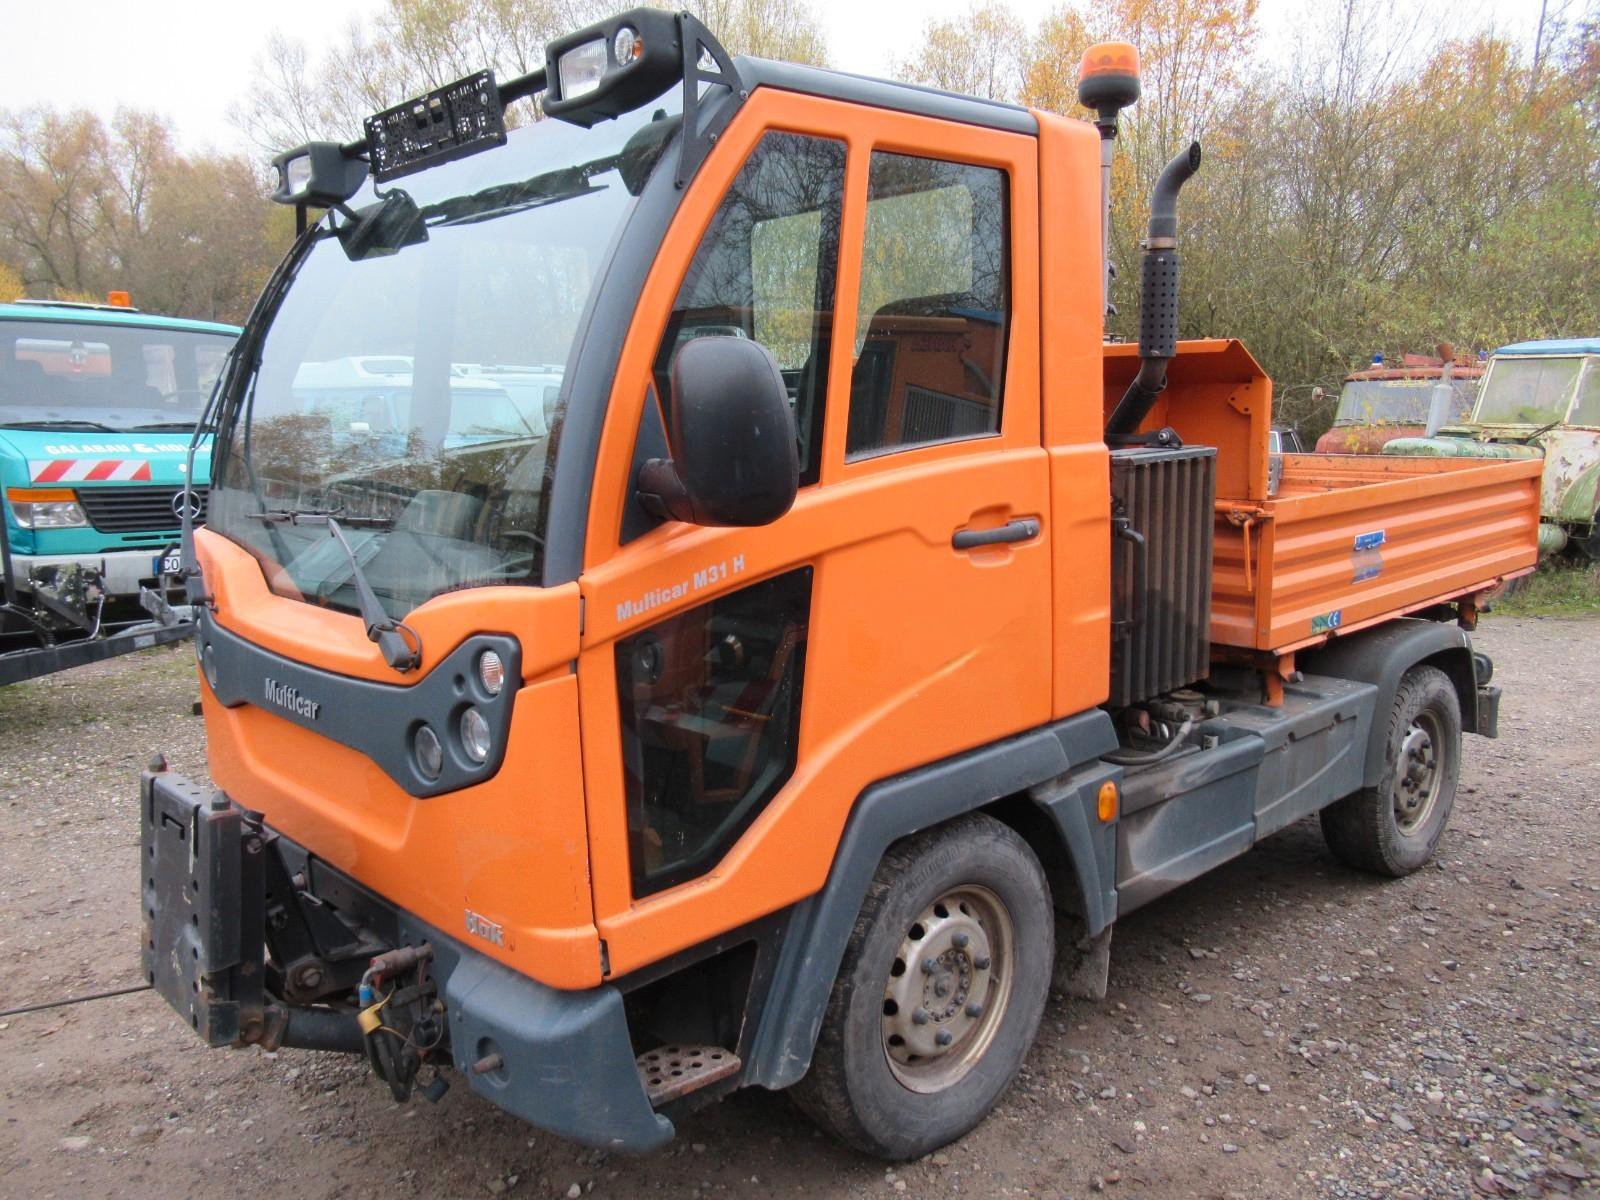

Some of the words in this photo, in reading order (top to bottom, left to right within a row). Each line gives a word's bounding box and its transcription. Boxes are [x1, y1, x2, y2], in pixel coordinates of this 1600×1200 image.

[616, 581, 689, 622] Multicar
[693, 562, 727, 590] M31
[732, 553, 745, 574] H
[264, 677, 320, 720] Multicar
